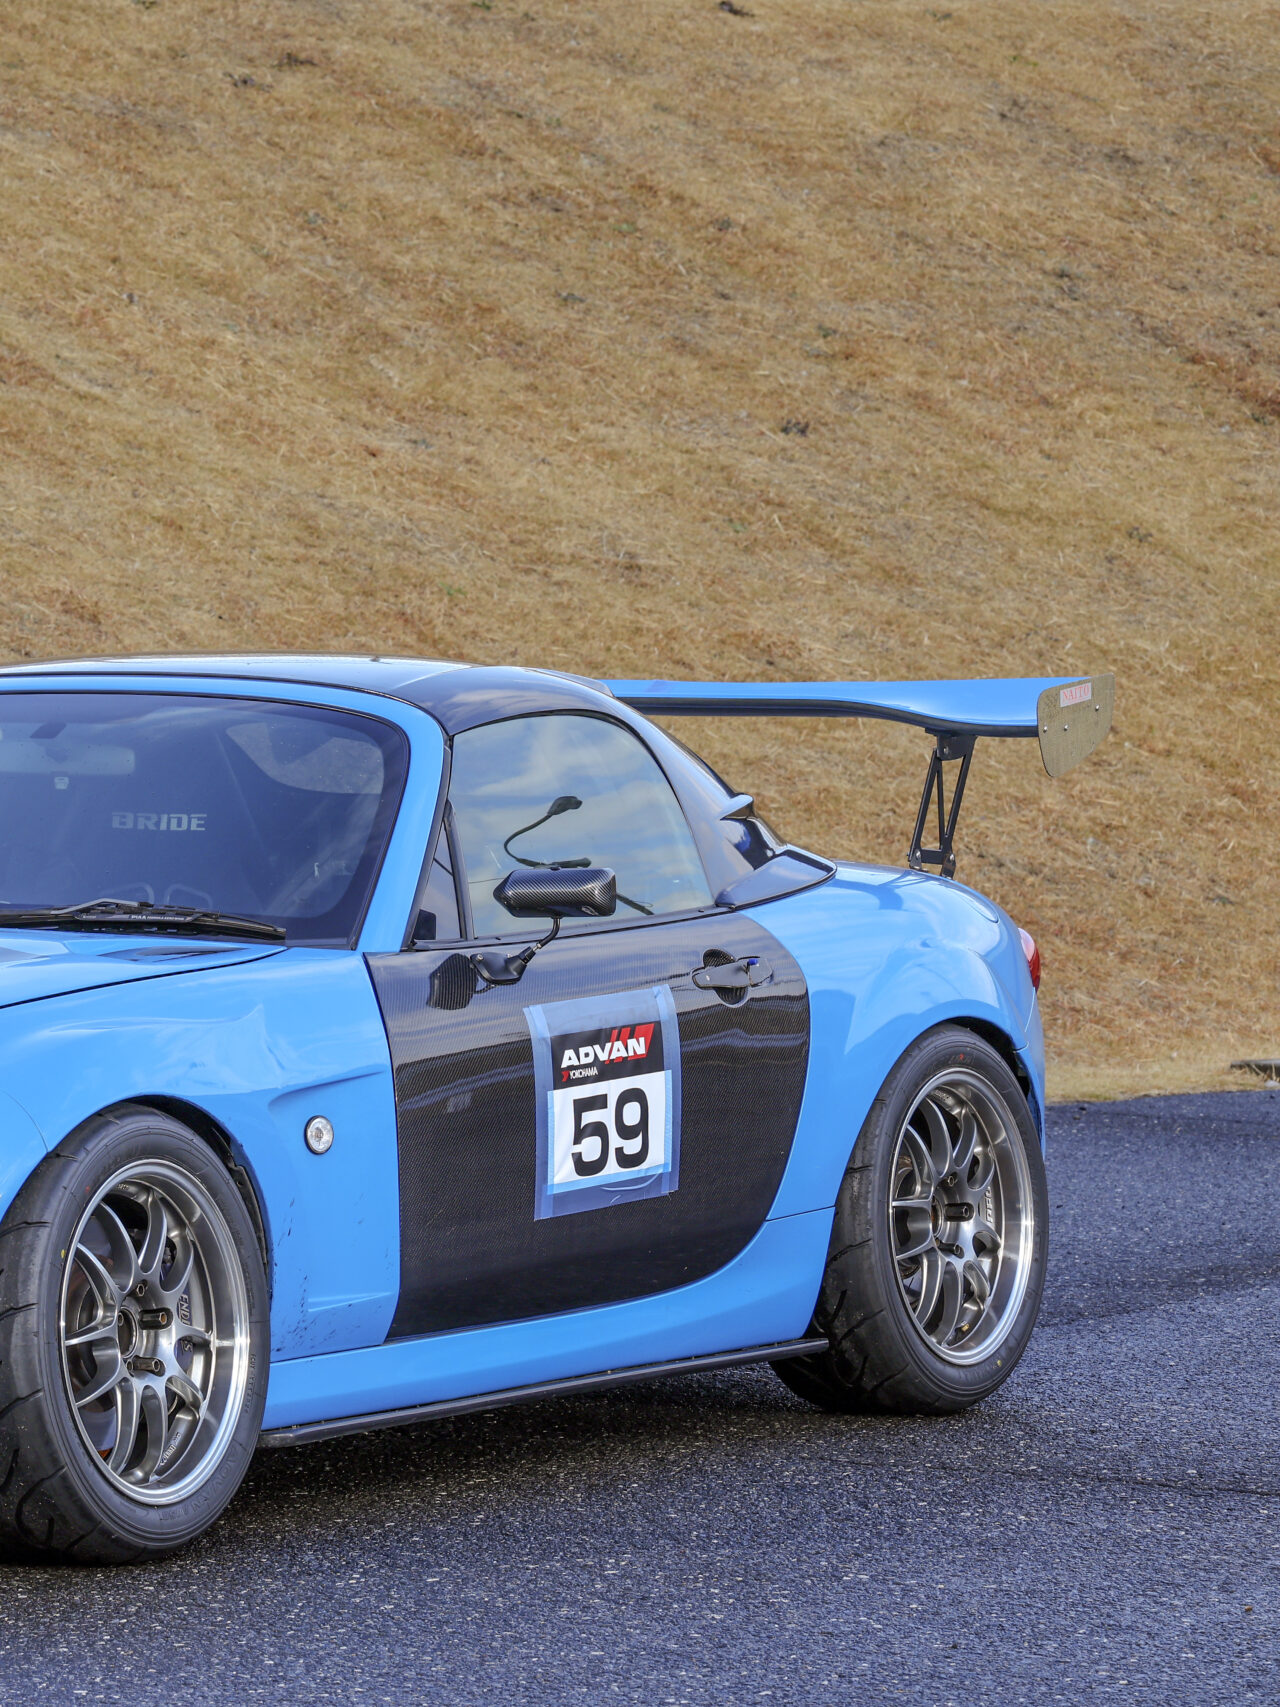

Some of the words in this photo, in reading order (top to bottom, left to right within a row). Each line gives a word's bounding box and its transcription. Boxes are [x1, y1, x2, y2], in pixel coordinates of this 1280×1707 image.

[1062, 684, 1090, 702] NAITO
[111, 812, 207, 831] BRIDE
[561, 1037, 646, 1068] ADVAN
[569, 1066, 599, 1079] YOKOHAMA
[571, 1087, 650, 1177] 59
